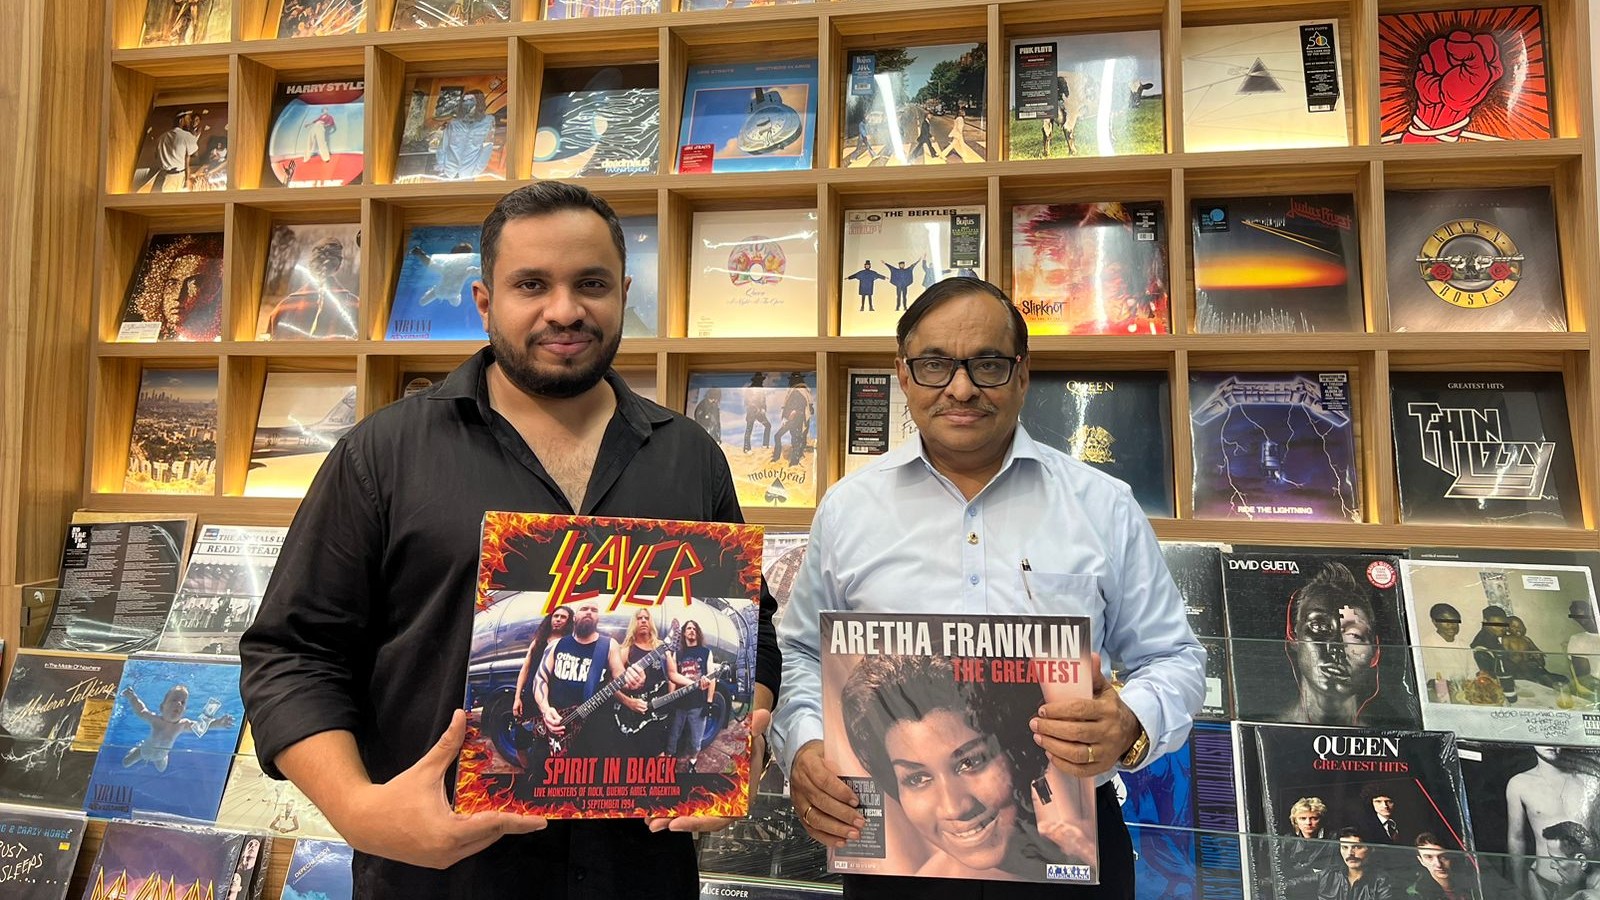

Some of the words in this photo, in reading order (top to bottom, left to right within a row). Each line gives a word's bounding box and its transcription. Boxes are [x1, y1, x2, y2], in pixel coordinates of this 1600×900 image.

[1019, 47, 1034, 55] PINK
[1034, 45, 1053, 54] FLOYD
[286, 84, 327, 95] HARRY
[908, 209, 958, 217] BEATLES
[1286, 197, 1322, 222] Judas
[1320, 207, 1352, 230] Priest
[1433, 221, 1480, 244] GUNS
[1438, 284, 1505, 306] ROSES
[394, 319, 432, 333] NIRVANA
[854, 377, 869, 385] PINK
[868, 377, 887, 385] FLOYD
[1066, 380, 1115, 393] QUEEN
[1486, 382, 1505, 390] HITS
[1408, 402, 1502, 477] THIN
[1237, 505, 1256, 514] RIDE
[1256, 506, 1272, 514] THE
[1272, 506, 1314, 515] LIGHTNING
[207, 544, 242, 554] READY
[247, 546, 282, 556] TEAD
[1228, 559, 1260, 571] DAVID
[1260, 559, 1300, 572] GUETTA
[542, 529, 704, 617] SLAYER
[830, 620, 933, 656] ARETHA
[942, 622, 1081, 660] FRANKLIN
[953, 658, 985, 684] THE
[991, 659, 1081, 685] GREATEST
[9, 692, 66, 725] Modern
[65, 676, 117, 707] Talking
[1313, 735, 1401, 761] QUEEN
[543, 757, 599, 785] SPIRIT
[603, 757, 621, 784] IN
[626, 757, 677, 784] BLACK
[1312, 760, 1378, 771] GREATEST
[1379, 762, 1409, 773] HITS
[533, 787, 546, 798] LIVE
[547, 787, 578, 798] MONSTERS
[578, 787, 586, 797] OF
[587, 787, 605, 798] ROCK,
[606, 786, 629, 796] BUENOS
[629, 786, 648, 797] AIRES,
[649, 786, 681, 797] ARGENTINA
[582, 799, 587, 809] 3
[587, 799, 620, 809] SEPTEMBER
[621, 799, 635, 809] 1994
[17, 825, 42, 836] CRAZY
[44, 827, 71, 839] HORSE
[1200, 836, 1242, 870] ROSES
[701, 882, 720, 896] ALICE
[720, 888, 749, 898] COOPER
